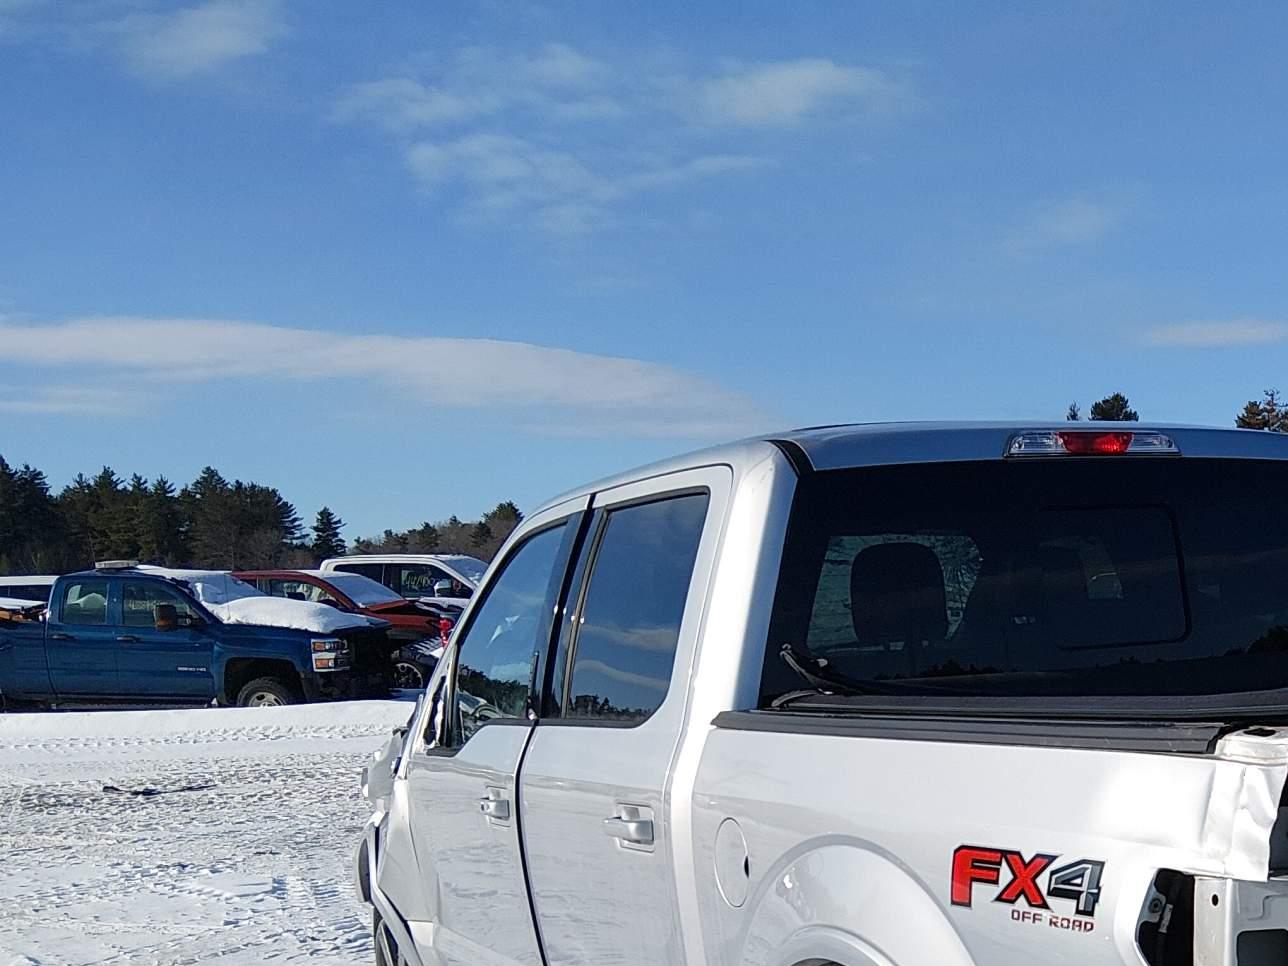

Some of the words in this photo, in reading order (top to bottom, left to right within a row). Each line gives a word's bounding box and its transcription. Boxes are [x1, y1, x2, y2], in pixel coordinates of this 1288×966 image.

[951, 845, 1106, 917] FX4
[1011, 909, 1043, 925] OFF
[1049, 915, 1095, 933] ROAD
